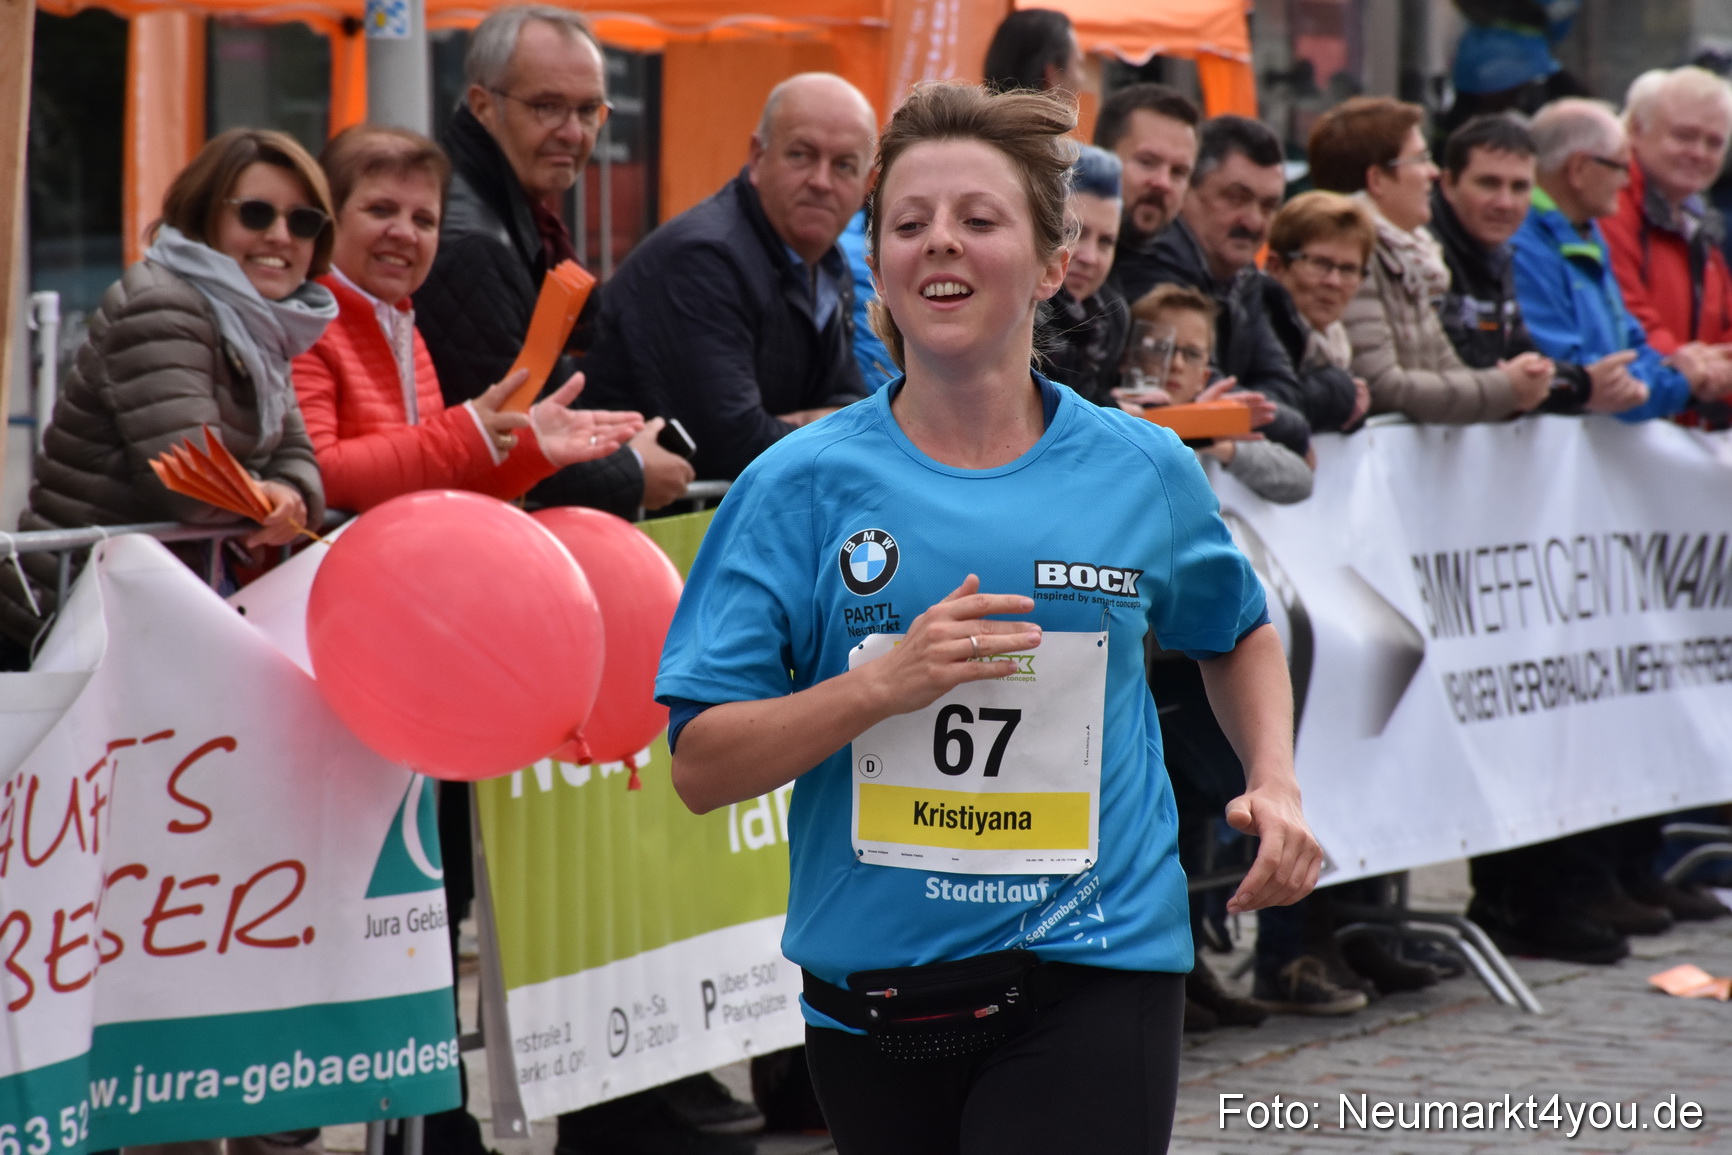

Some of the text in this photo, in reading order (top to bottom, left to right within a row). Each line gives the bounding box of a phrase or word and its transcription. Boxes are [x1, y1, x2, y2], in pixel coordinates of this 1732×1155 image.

[843, 531, 895, 553] BMW
[1036, 561, 1143, 596] BOCK
[1033, 590, 1141, 610] inspired by smart concepts
[844, 602, 900, 624] PARTL
[847, 620, 900, 638] Neumarkt
[1006, 675, 1036, 683] concepts
[933, 704, 1022, 778] 67
[866, 760, 875, 773] D
[913, 801, 1032, 836] Kristiyana
[925, 876, 1051, 904] Stadtlauf
[1025, 896, 1079, 943] September
[1077, 875, 1100, 902] 2017
[364, 914, 401, 939] Jura
[701, 978, 717, 1030] P
